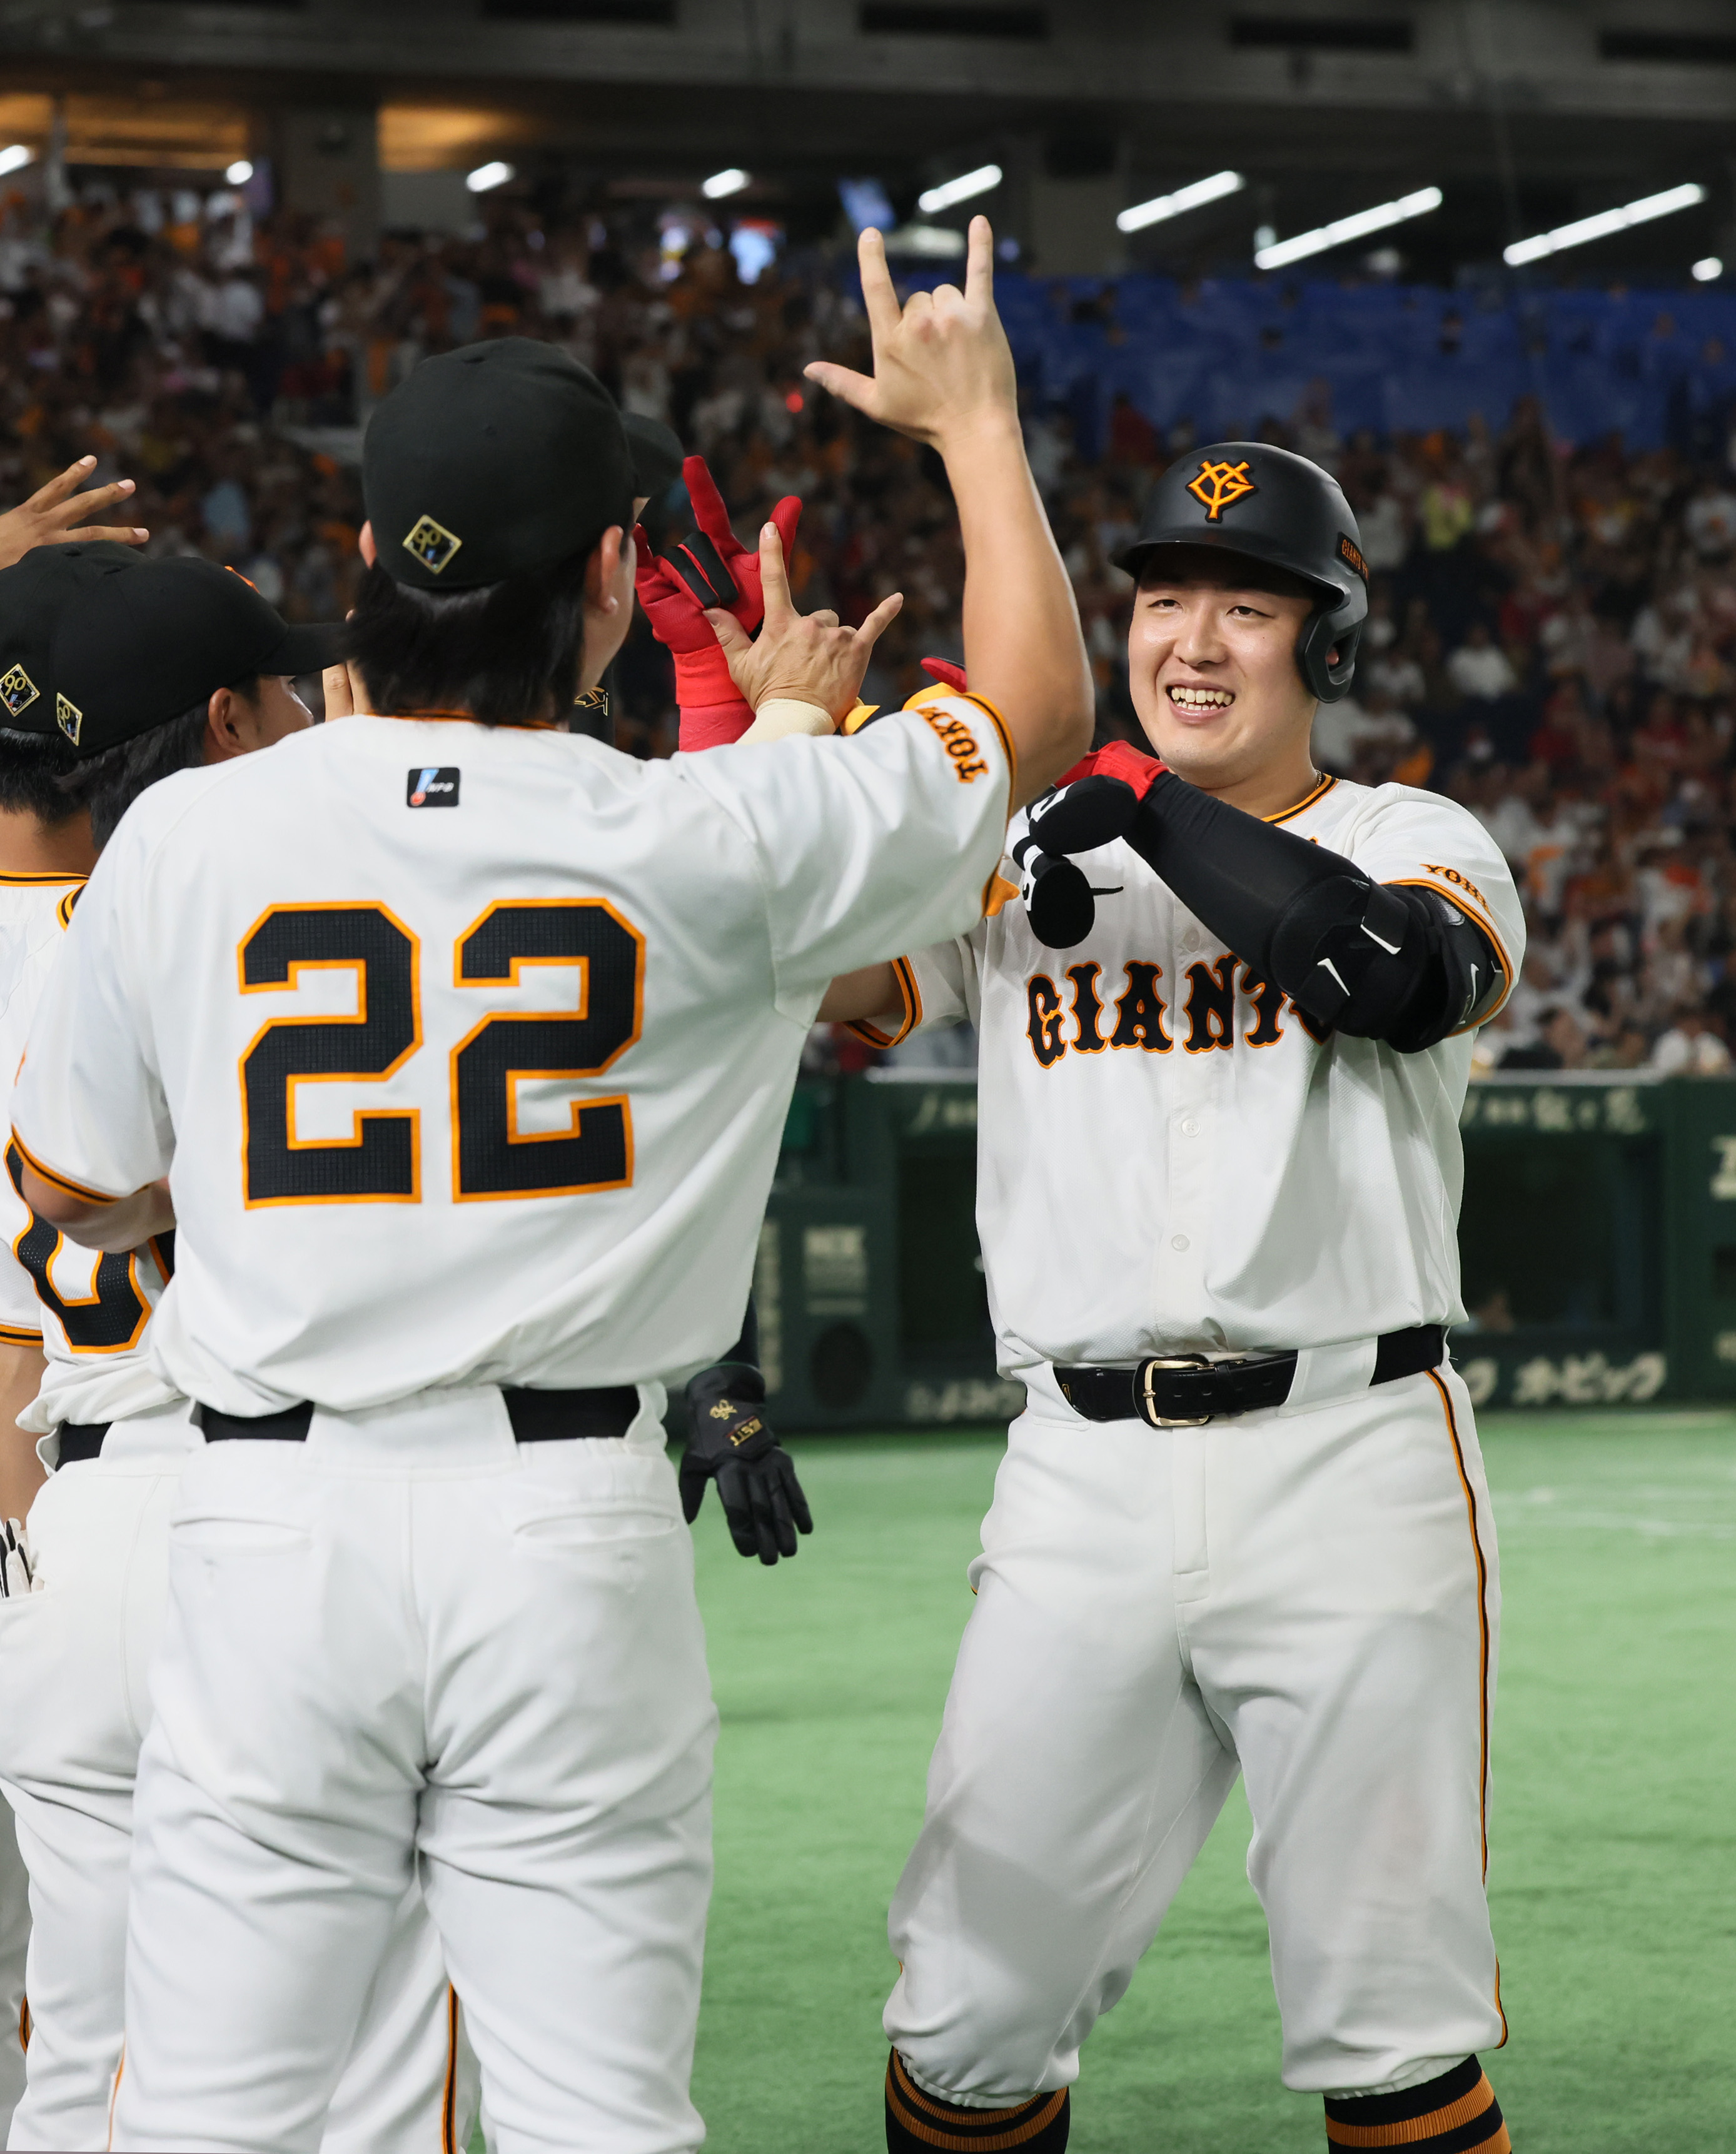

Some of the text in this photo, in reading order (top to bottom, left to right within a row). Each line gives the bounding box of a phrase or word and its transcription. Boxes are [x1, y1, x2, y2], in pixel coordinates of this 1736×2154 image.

[4, 675, 27, 696] 90
[237, 897, 647, 1211] 22
[1026, 952, 1334, 1070] GIANT
